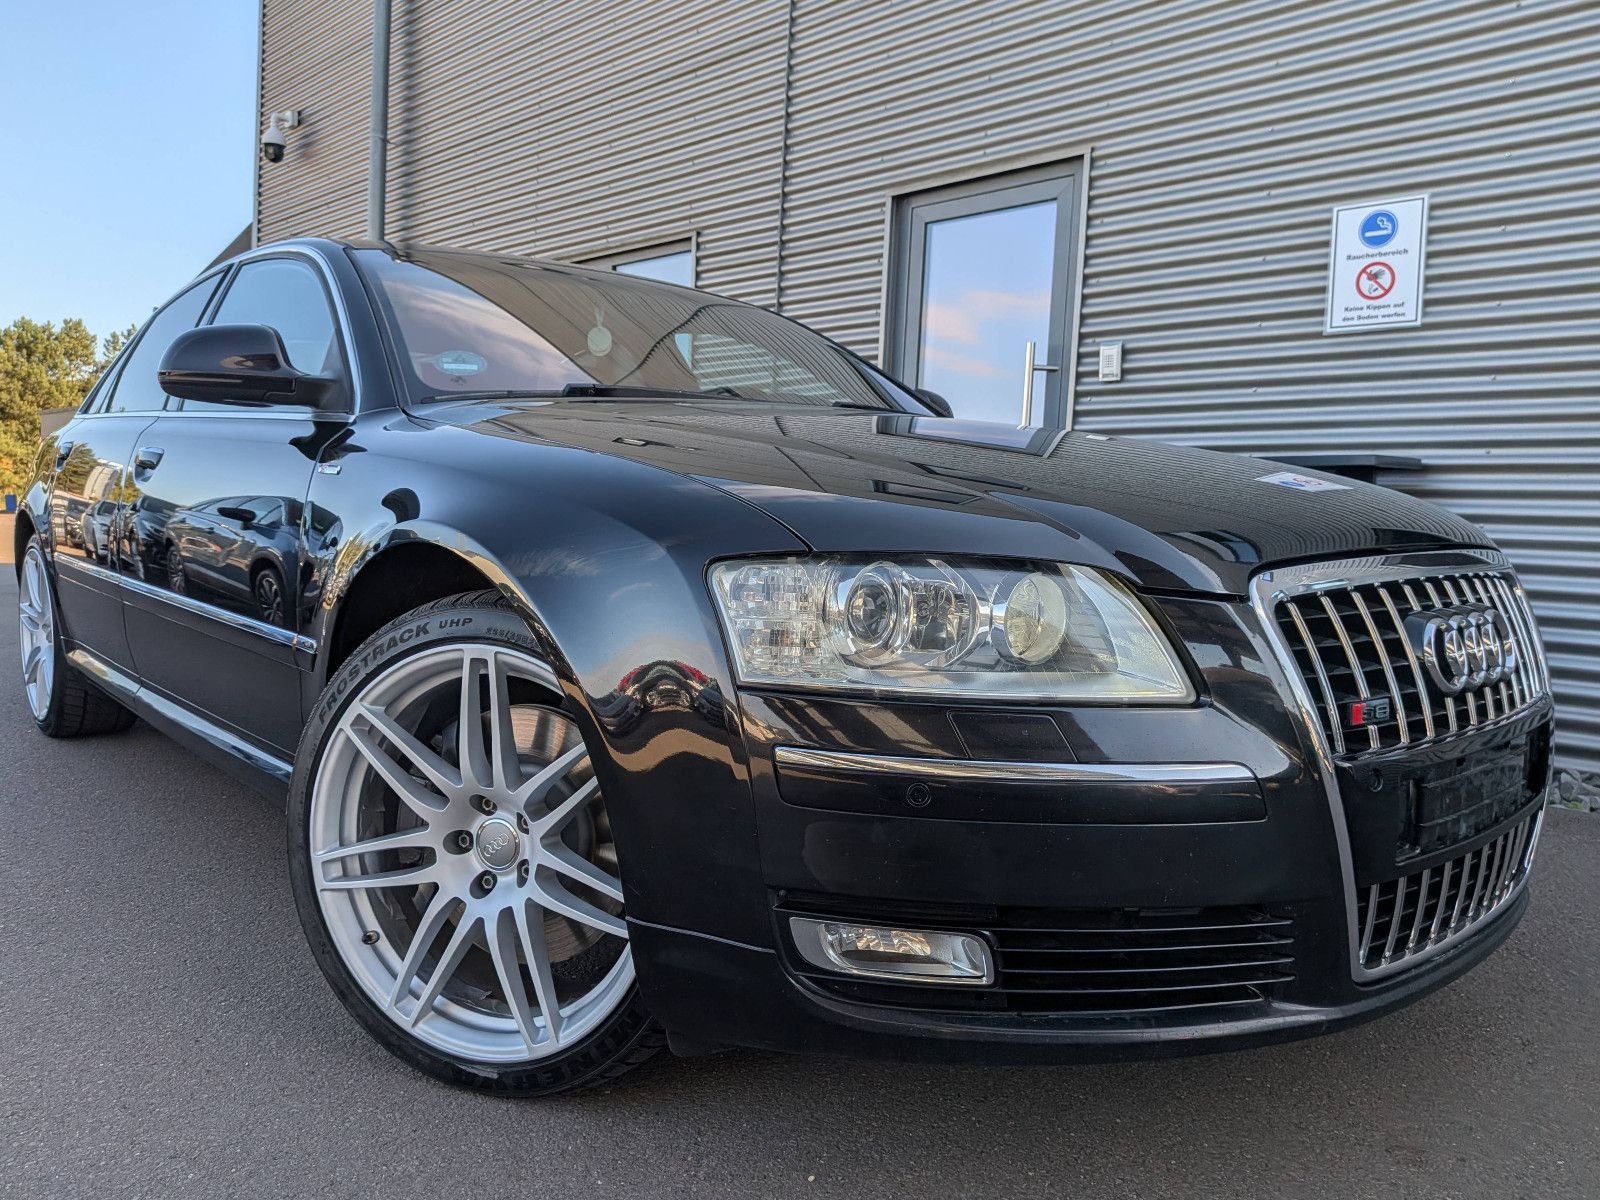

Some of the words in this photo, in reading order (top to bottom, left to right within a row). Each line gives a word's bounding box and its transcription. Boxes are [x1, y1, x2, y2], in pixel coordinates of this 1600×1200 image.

[1346, 248, 1408, 260] Raucherbereich
[1344, 304, 1364, 312] Keine
[1366, 303, 1391, 311] Kippen
[1381, 311, 1405, 319] werfen
[318, 621, 430, 725] FROSTRACK
[438, 617, 473, 630] UHP
